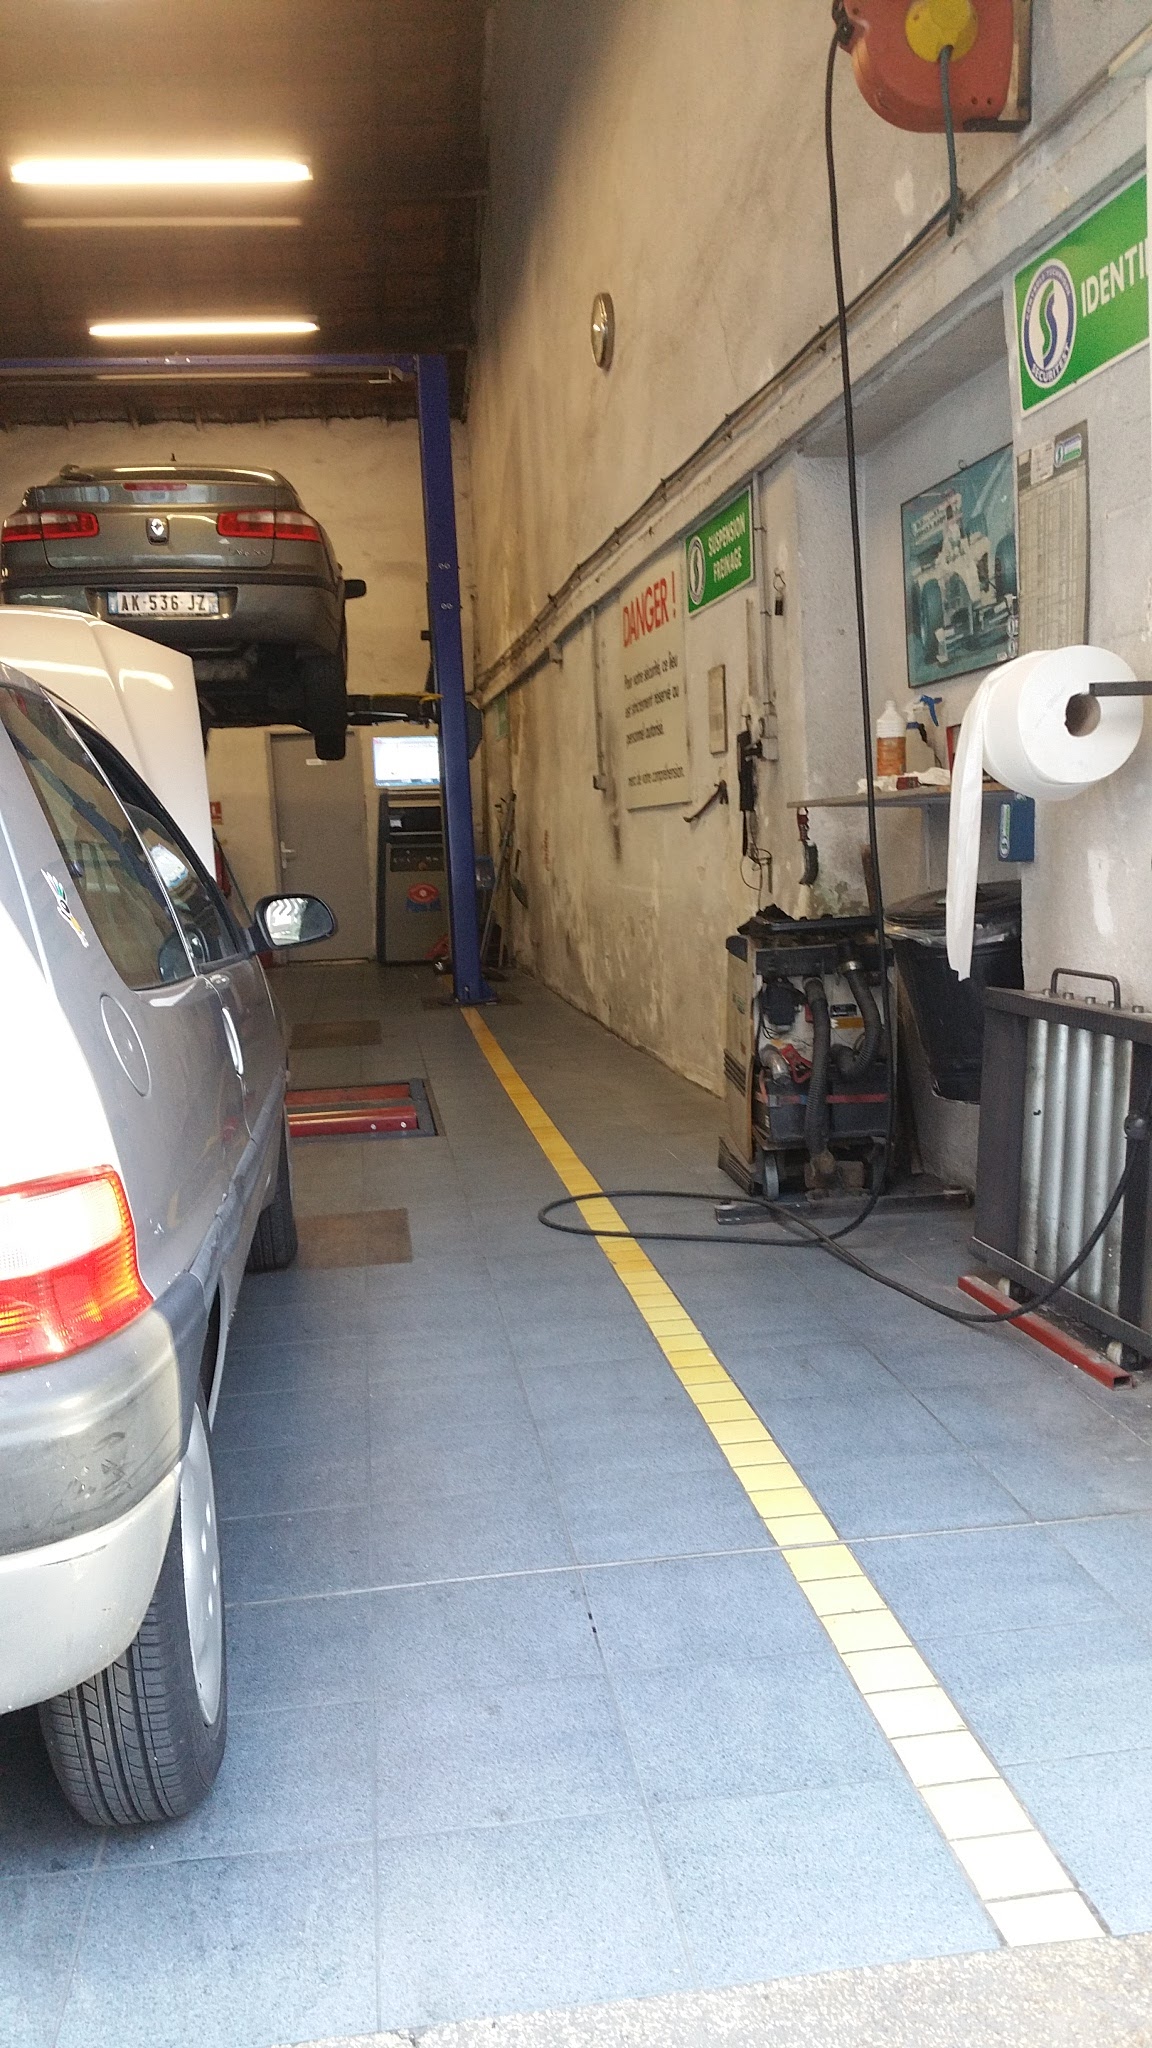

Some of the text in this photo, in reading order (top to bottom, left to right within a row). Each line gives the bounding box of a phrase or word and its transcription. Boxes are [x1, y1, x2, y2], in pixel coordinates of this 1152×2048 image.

[1081, 239, 1148, 318] IDENTI
[708, 512, 746, 558] SUSPENSION
[713, 546, 742, 584] FREINAGE
[623, 577, 669, 648] DANGER
